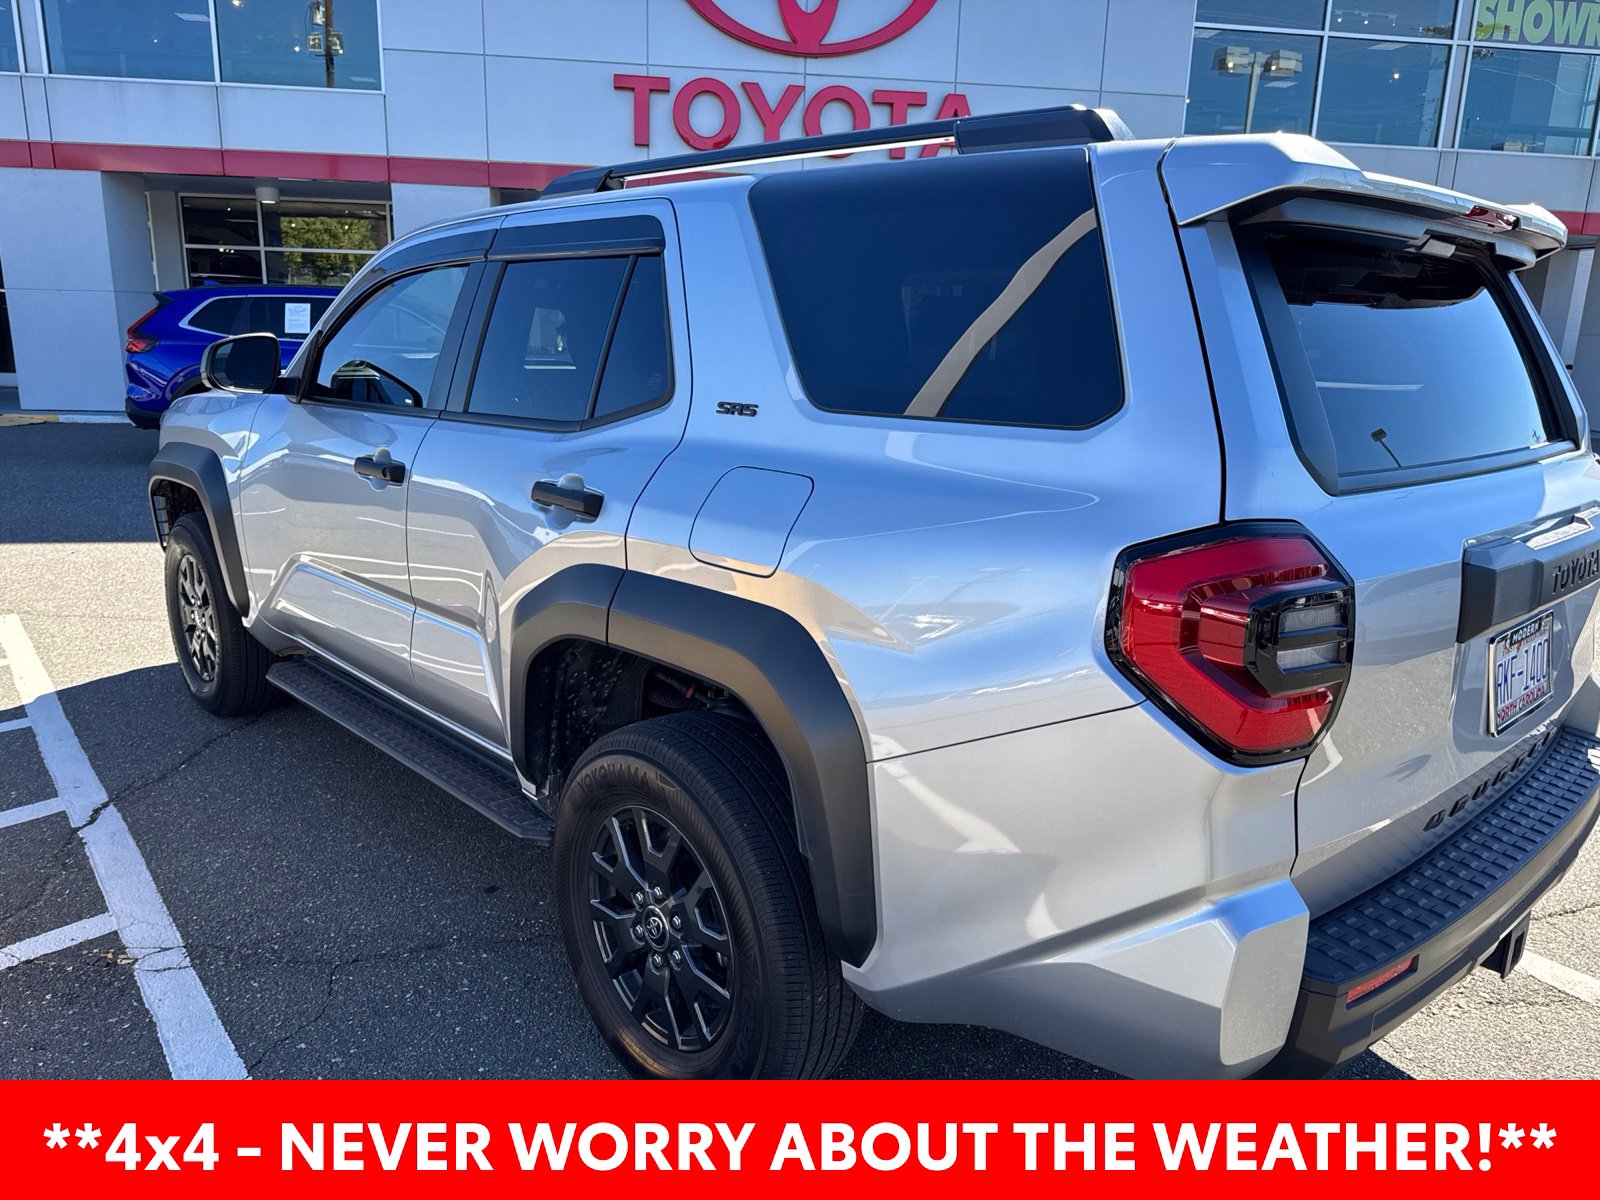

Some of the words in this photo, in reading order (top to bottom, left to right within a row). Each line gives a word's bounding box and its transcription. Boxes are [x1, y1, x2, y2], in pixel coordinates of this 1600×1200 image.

[716, 401, 759, 418] SR5
[1552, 549, 1600, 595] TOYOTA
[1511, 619, 1542, 645] MODERN
[1518, 684, 1547, 711] CAROLINA
[577, 762, 651, 796] YOKOHAMA
